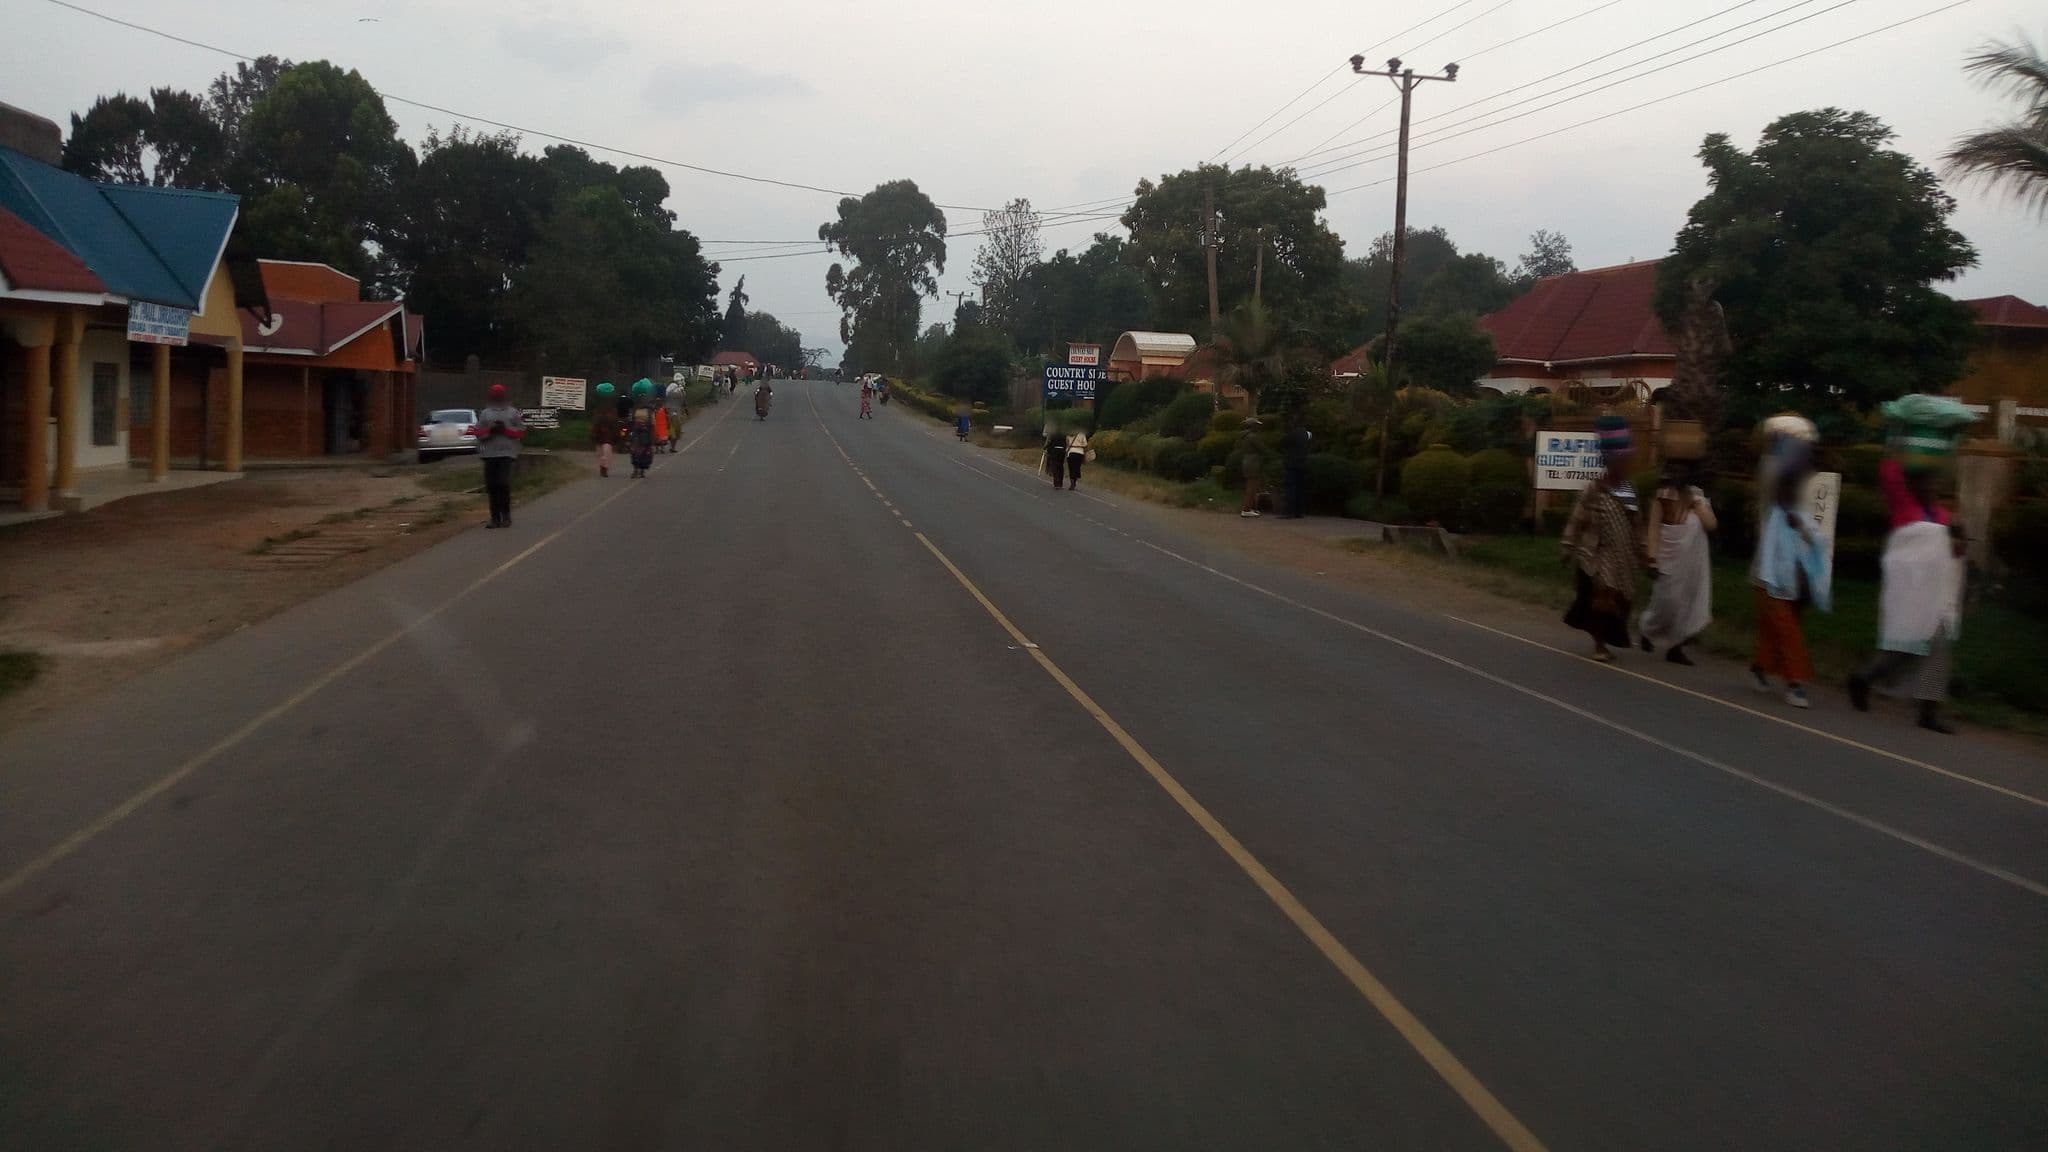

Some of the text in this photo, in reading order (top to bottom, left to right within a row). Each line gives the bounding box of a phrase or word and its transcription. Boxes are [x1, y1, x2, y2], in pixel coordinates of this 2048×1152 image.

[1046, 367, 1086, 378] COUNTRY
[1047, 379, 1096, 390] GUEST HOU
[1537, 455, 1607, 468] GUEST HOU
